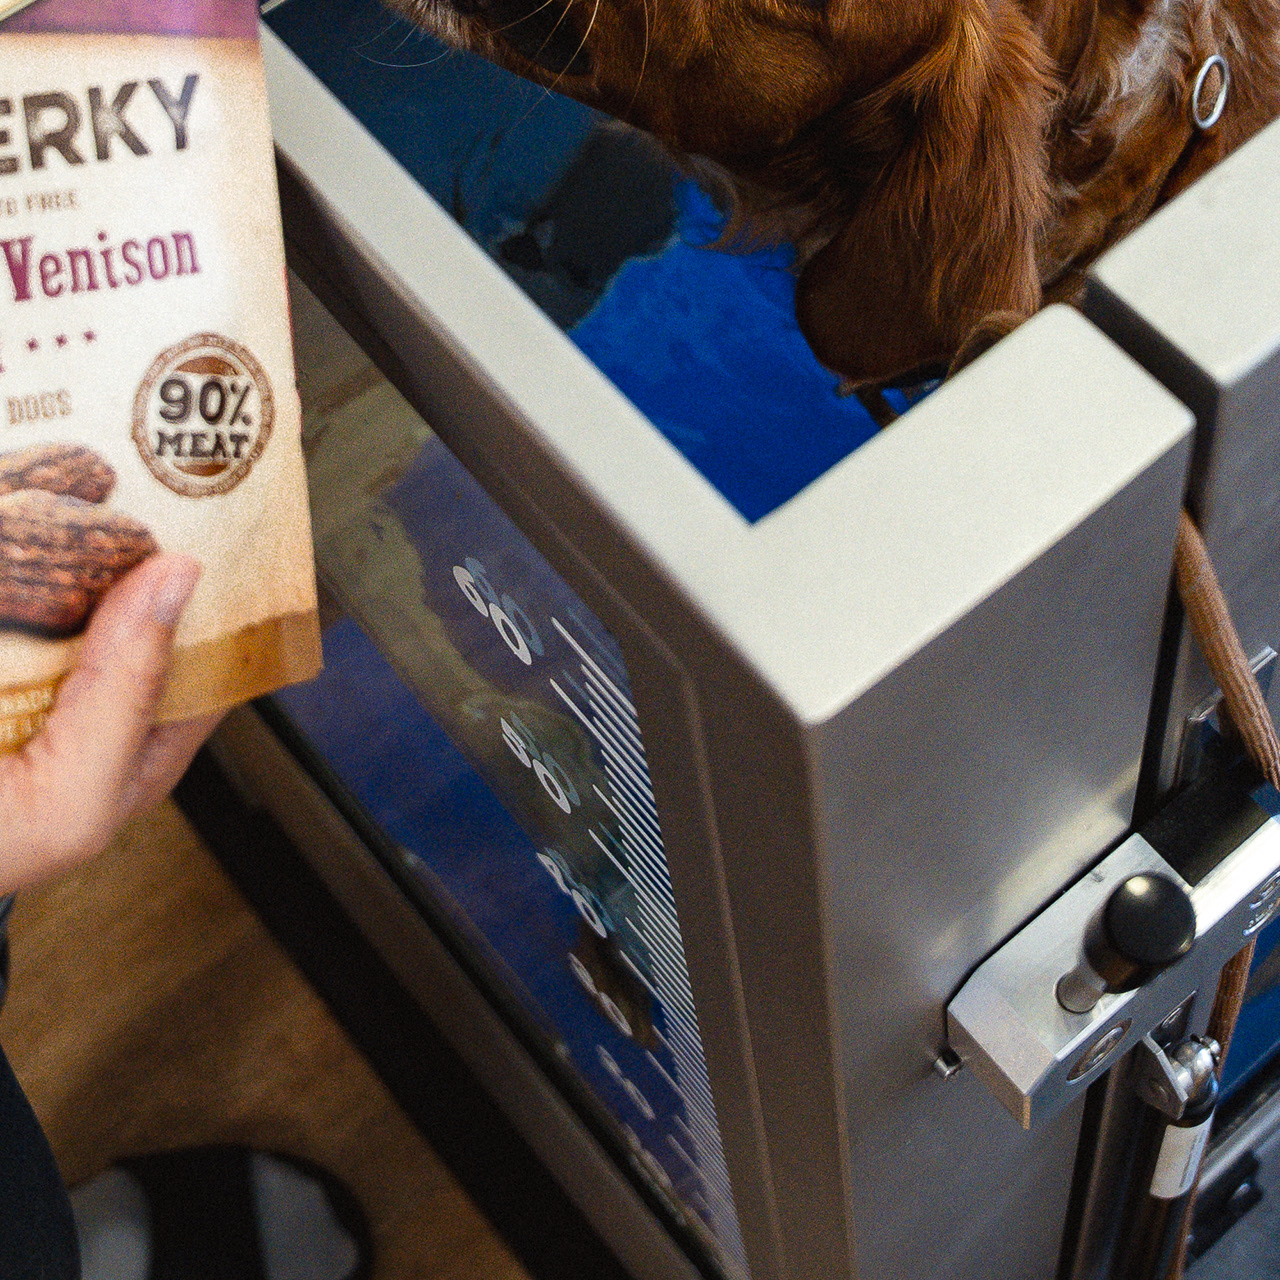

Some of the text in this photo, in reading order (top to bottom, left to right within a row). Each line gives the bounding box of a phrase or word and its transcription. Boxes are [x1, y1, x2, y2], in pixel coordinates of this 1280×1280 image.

[26, 189, 78, 212] FREE
[6, 389, 74, 426] DOGS
[158, 377, 253, 426] 90%
[155, 430, 250, 459] MEAT
[453, 565, 532, 665] 60
[501, 717, 571, 814] 50
[536, 852, 608, 939] 40
